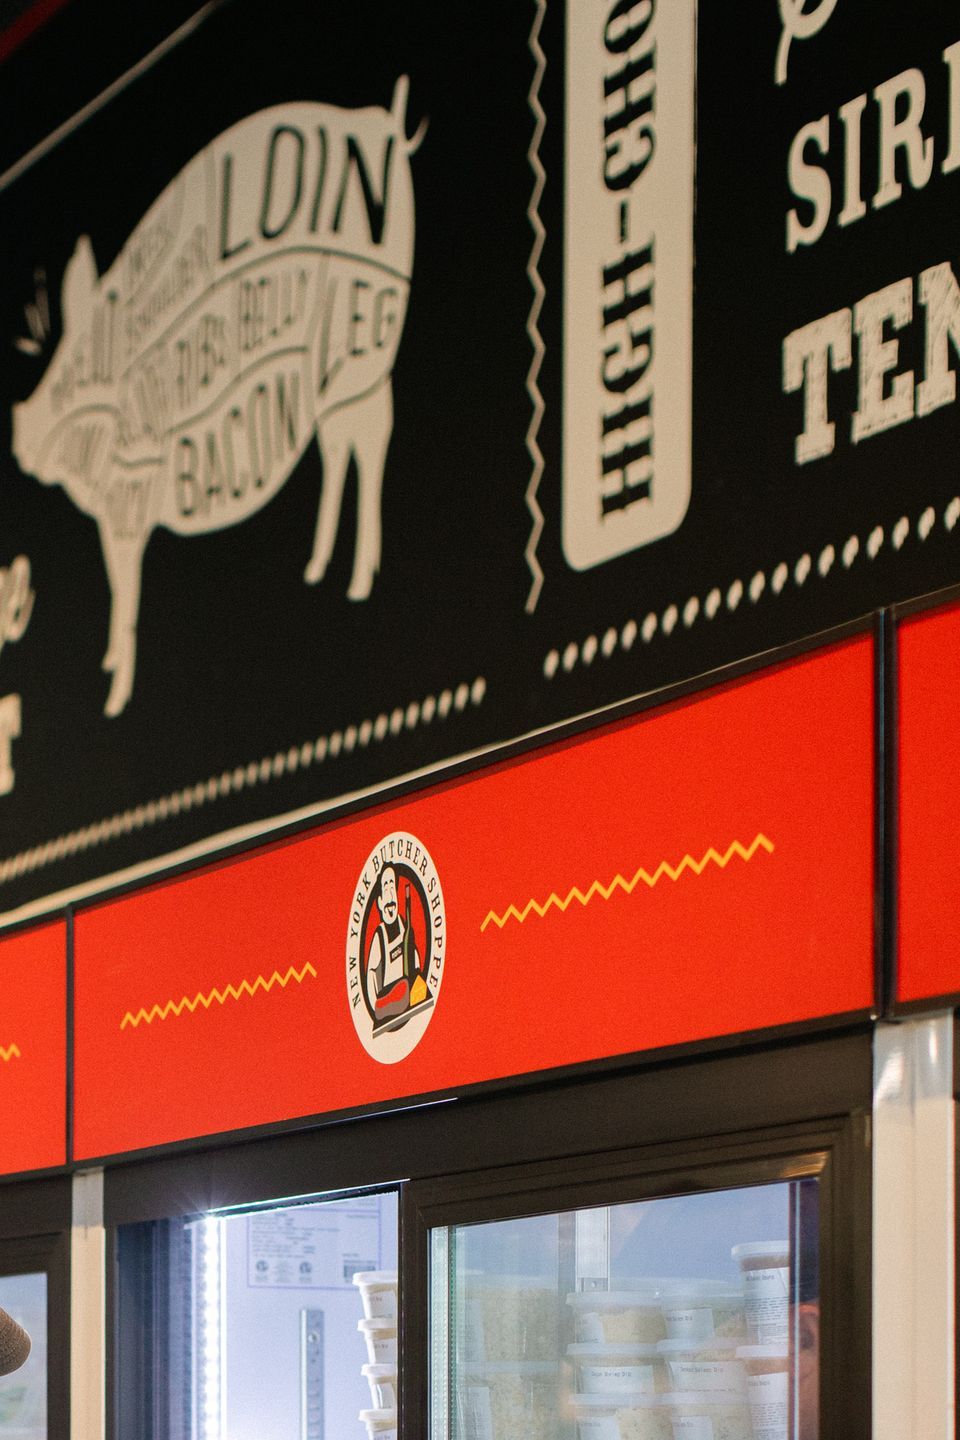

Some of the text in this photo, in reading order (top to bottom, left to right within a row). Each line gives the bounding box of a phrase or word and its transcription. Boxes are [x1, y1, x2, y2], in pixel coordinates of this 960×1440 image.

[221, 124, 395, 262] LOIN
[319, 278, 396, 396] LEG
[174, 370, 300, 517] BACON
[348, 838, 443, 1009] NEW YORK BUTCHER SHOPPE
